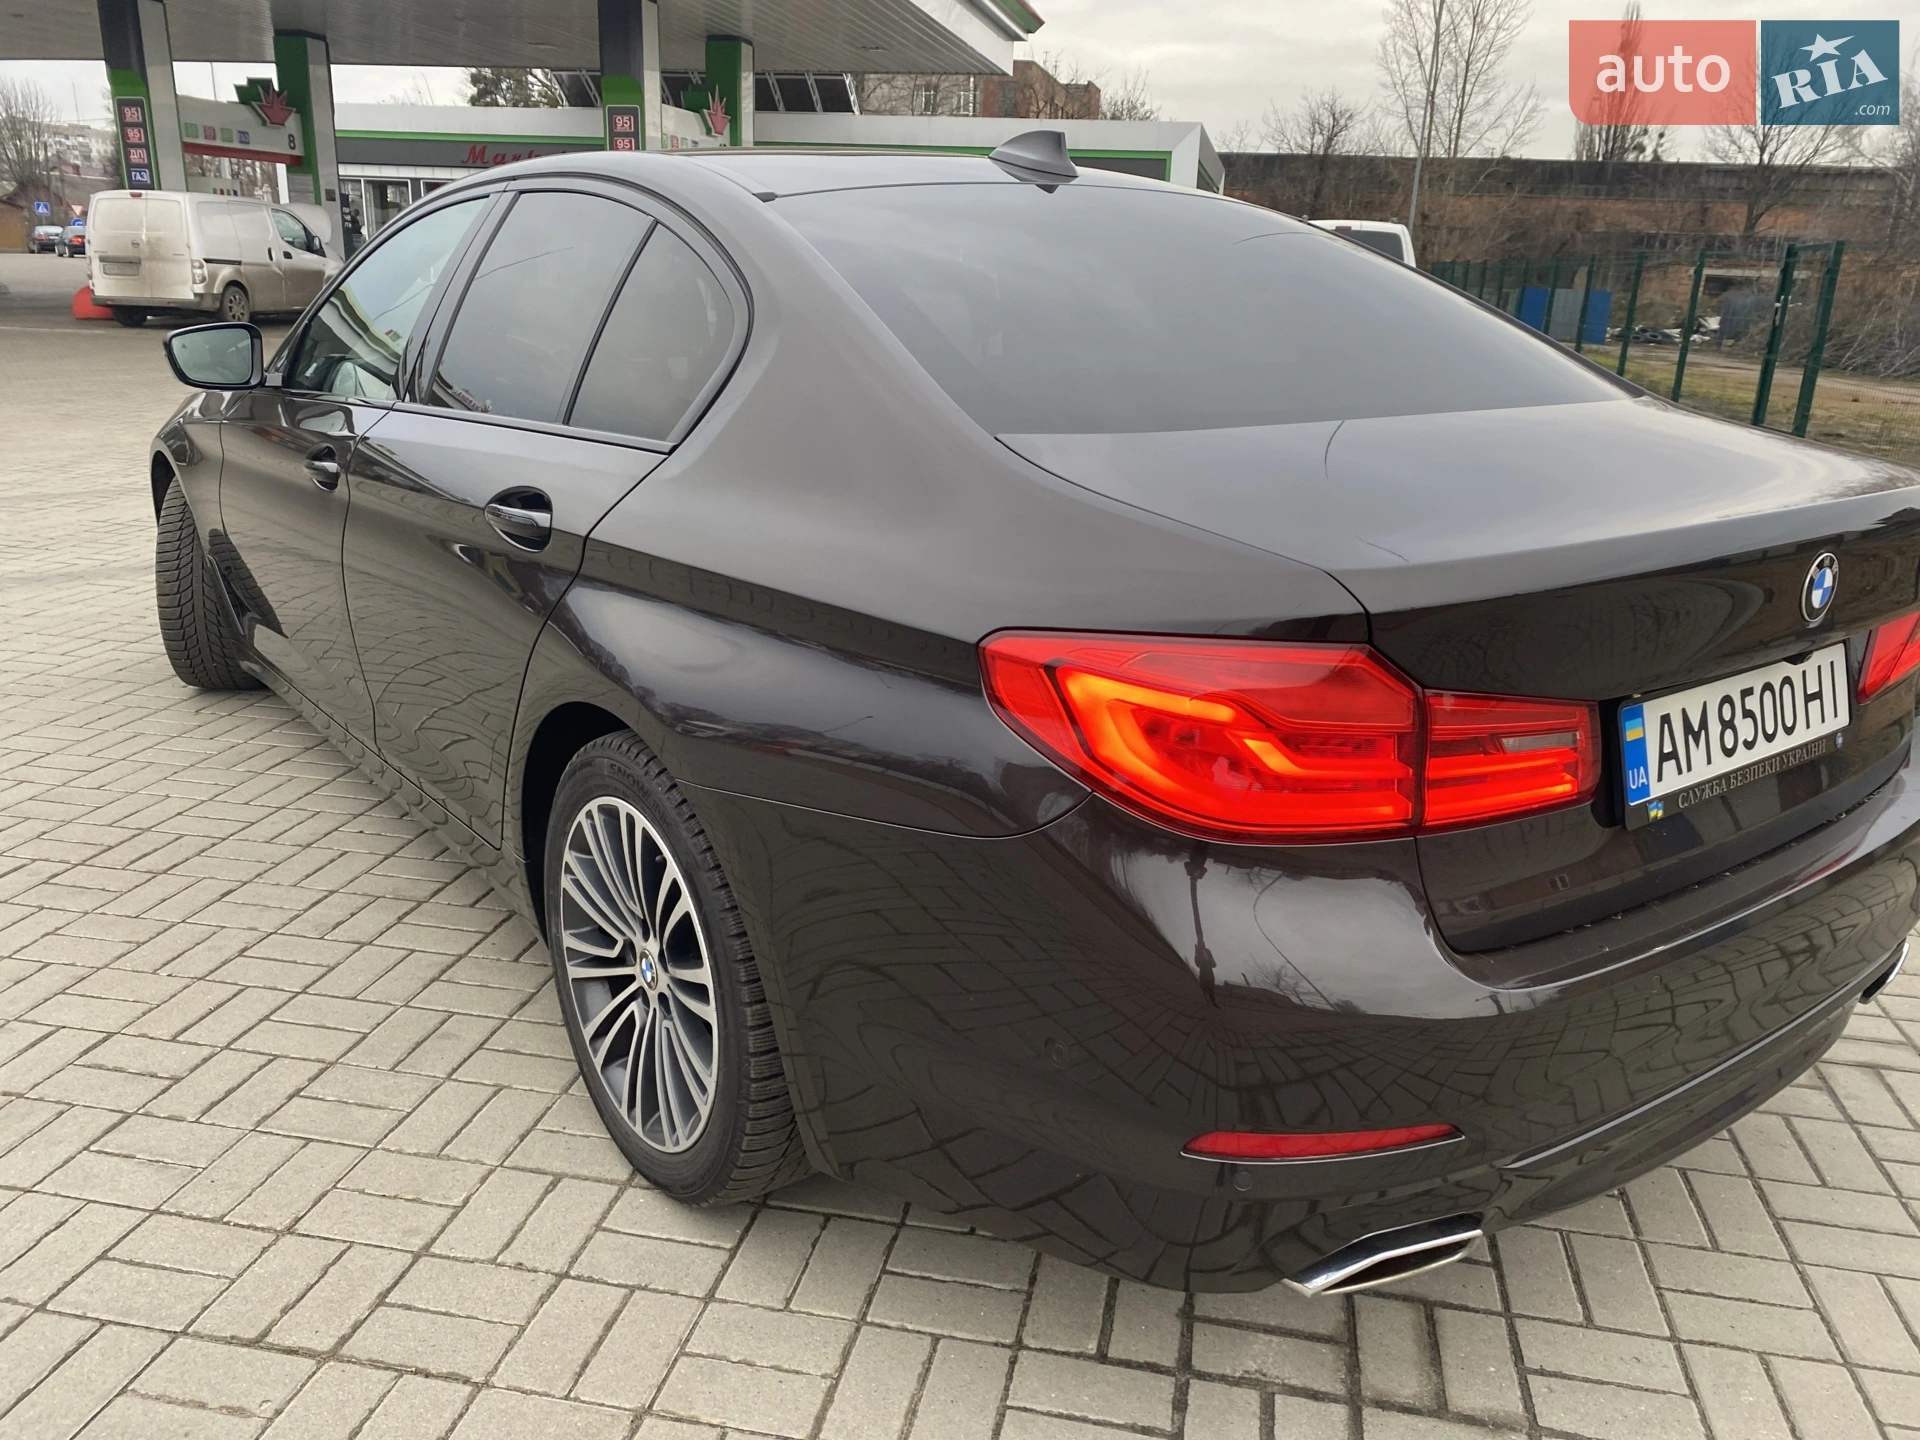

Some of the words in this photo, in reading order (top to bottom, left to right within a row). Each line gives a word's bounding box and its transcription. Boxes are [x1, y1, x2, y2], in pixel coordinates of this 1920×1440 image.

[124, 107, 138, 118] 95
[616, 116, 630, 127] 95
[127, 129, 140, 138] 95
[287, 133, 296, 150] 8
[617, 139, 630, 149] 95
[132, 171, 147, 181] ГАЗ
[1629, 768, 1648, 790] UA
[1678, 778, 1728, 809] СЛУЖБА
[1730, 757, 1781, 789] БЕЗПЕКИ
